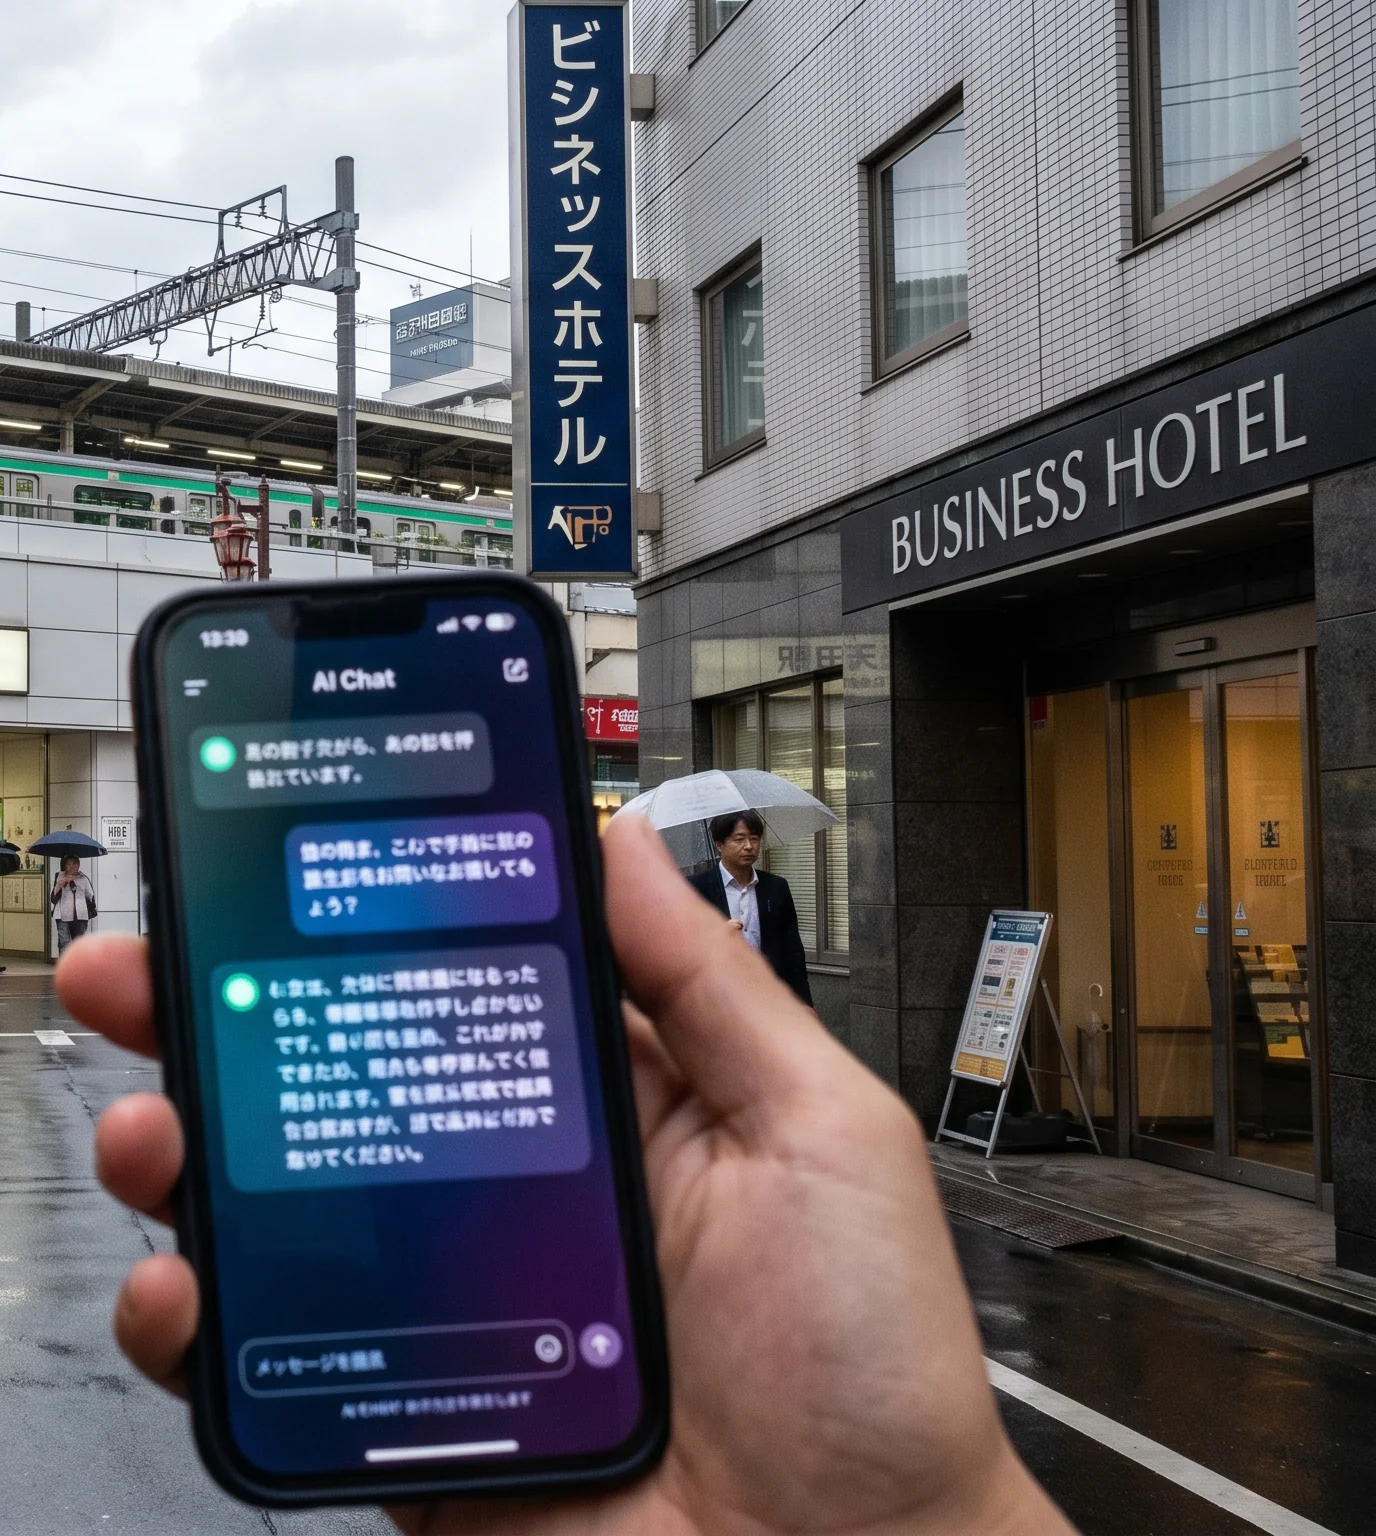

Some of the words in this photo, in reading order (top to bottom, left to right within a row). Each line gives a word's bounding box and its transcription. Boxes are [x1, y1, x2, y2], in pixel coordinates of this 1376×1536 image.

[550, 20, 607, 466] ビシネッスホテル
[891, 449, 1087, 575] BUSINESS
[1106, 373, 1308, 507] HOTEL
[312, 670, 335, 693] AI
[340, 667, 397, 690] Chat
